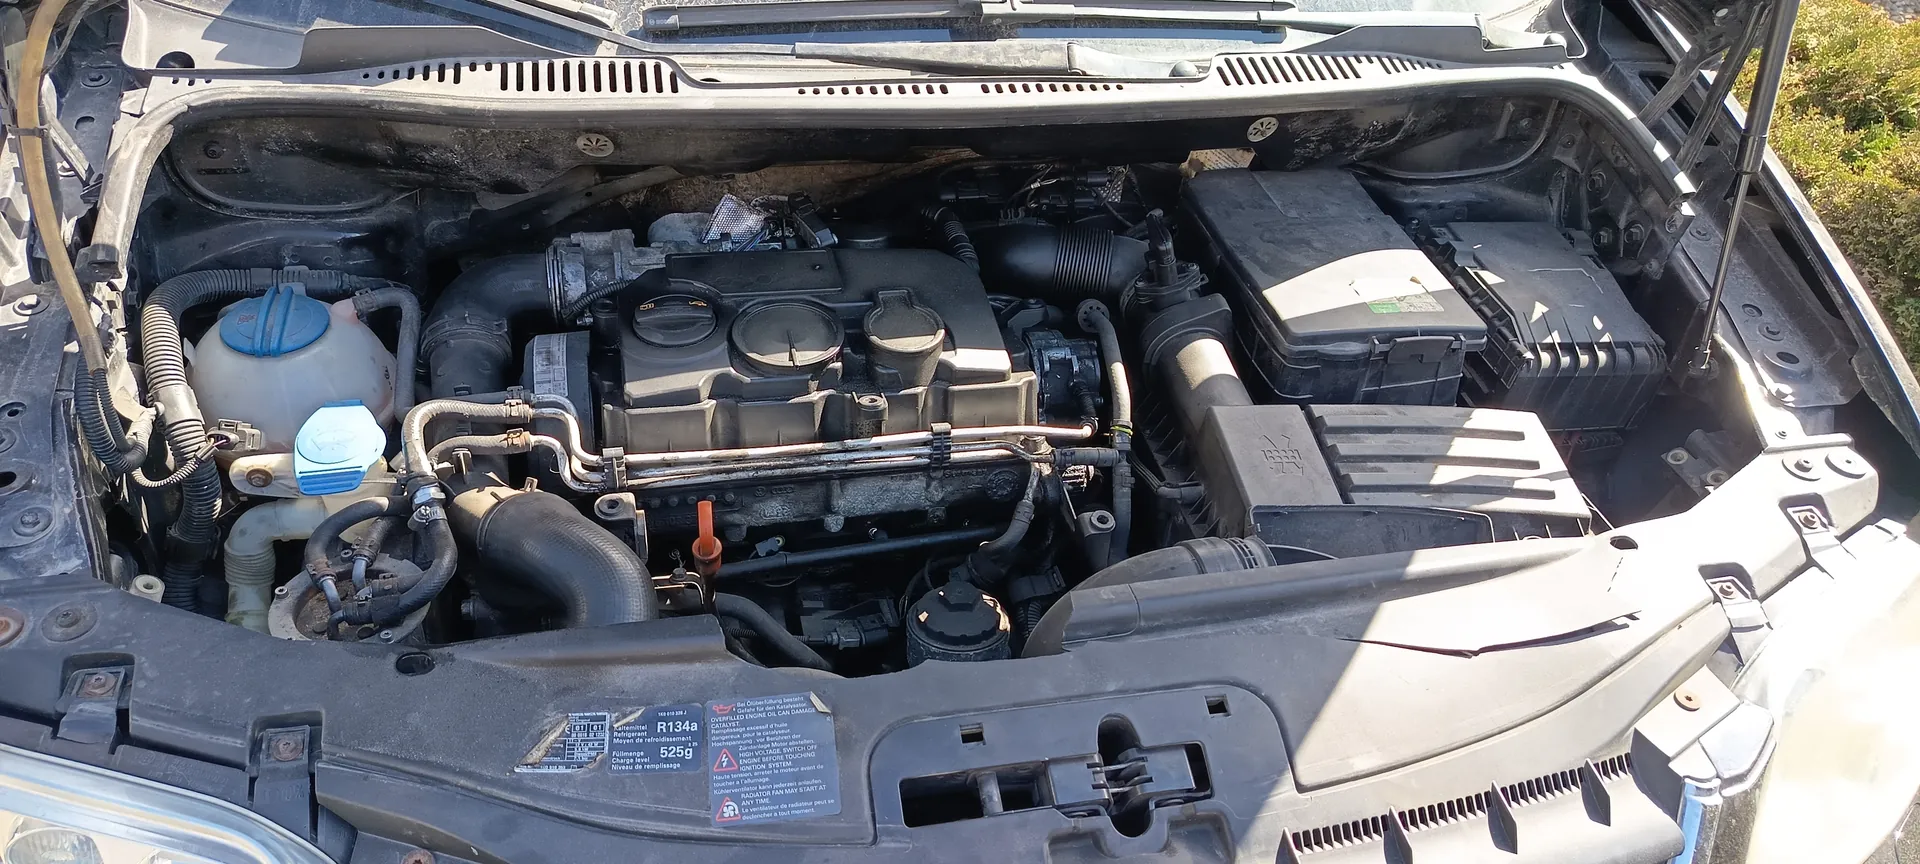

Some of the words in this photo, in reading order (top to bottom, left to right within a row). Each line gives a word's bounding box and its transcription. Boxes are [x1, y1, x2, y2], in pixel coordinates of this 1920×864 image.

[656, 720, 698, 733] R134a
[644, 735, 692, 743] refroidissement
[659, 745, 693, 760] 525g
[784, 751, 816, 759] TOUCHING
[643, 762, 681, 770] remplissage
[739, 763, 766, 771] IGNITION
[741, 791, 771, 799] RADIATOR
